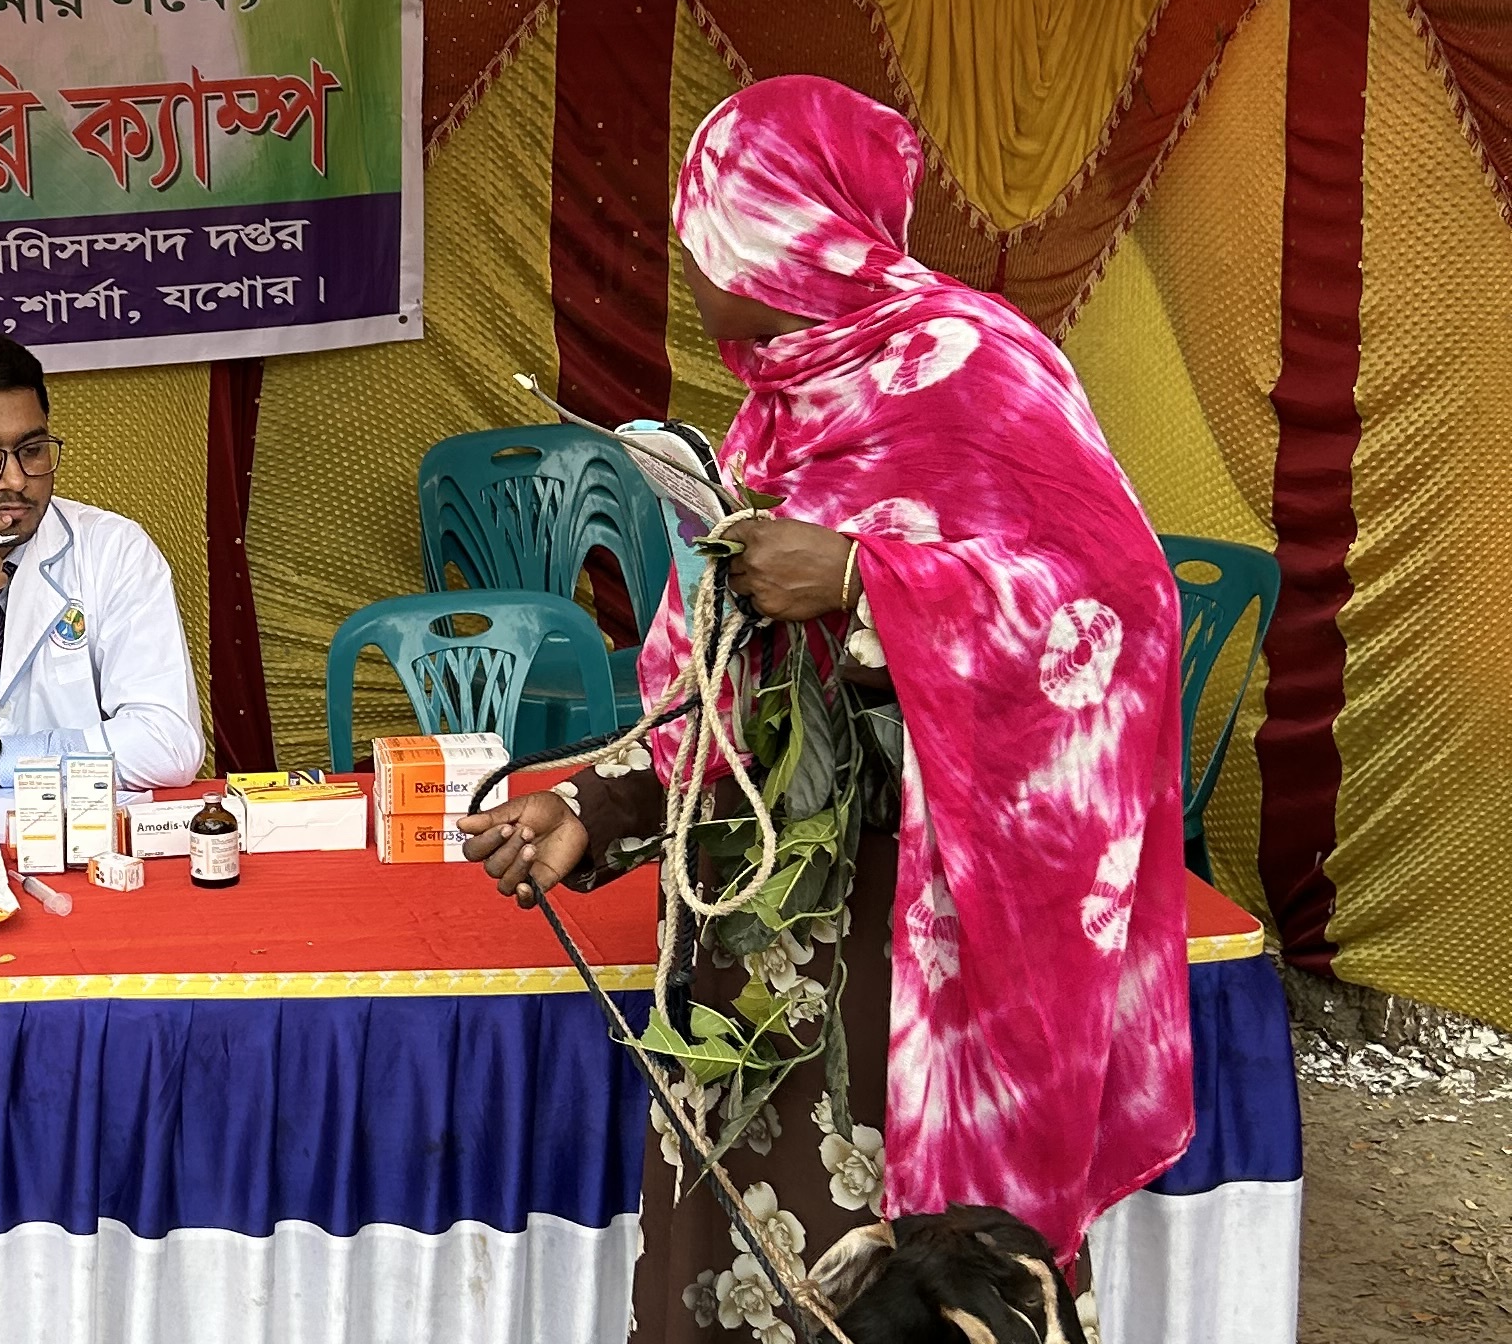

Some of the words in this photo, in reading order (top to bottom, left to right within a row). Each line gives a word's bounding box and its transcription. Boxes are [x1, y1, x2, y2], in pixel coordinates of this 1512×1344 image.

[58, 58, 343, 193] ক্যাম্প
[201, 216, 311, 257] দপ্তর
[157, 275, 302, 314] যশোর
[415, 781, 469, 793] Renadex
[137, 819, 191, 832] Amodis-V
